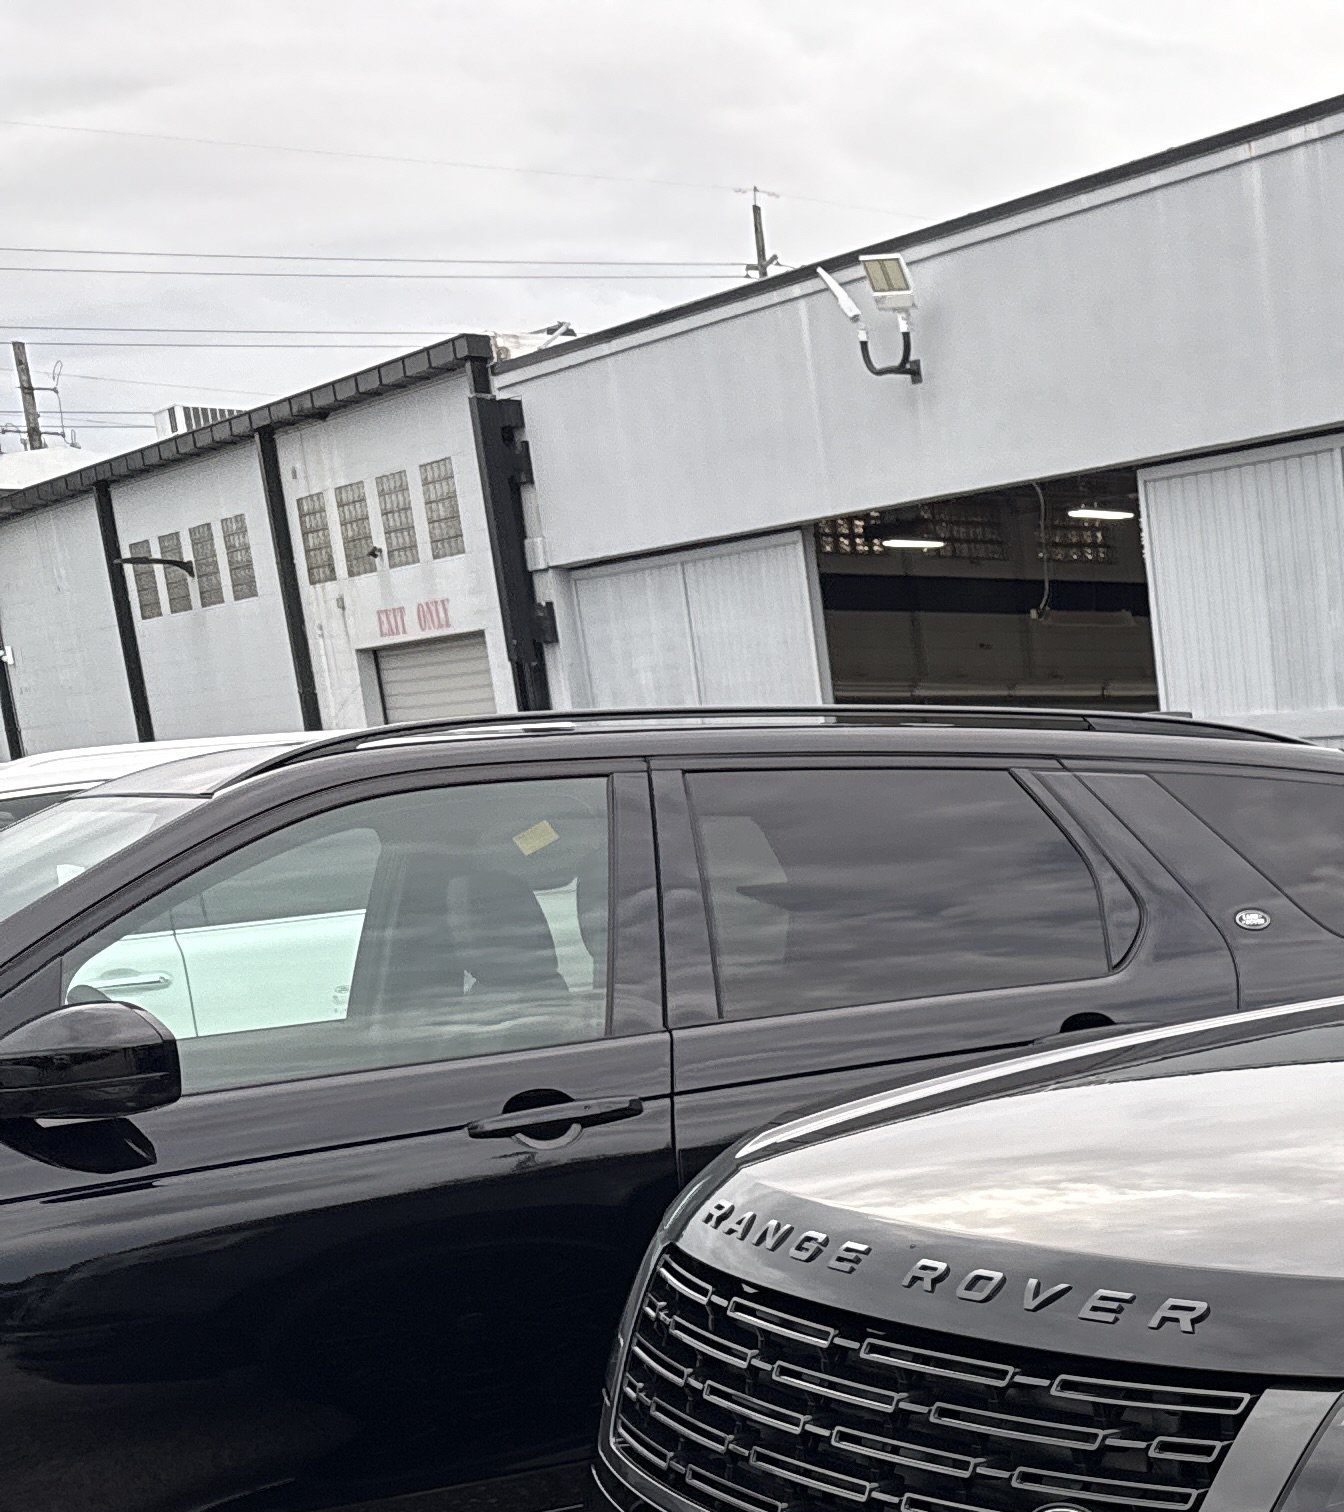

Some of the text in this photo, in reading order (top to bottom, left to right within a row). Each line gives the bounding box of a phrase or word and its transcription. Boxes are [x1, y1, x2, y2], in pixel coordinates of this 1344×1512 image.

[376, 598, 451, 637] EXIT ONLY
[700, 1197, 1212, 1335] RANGE ROVER
